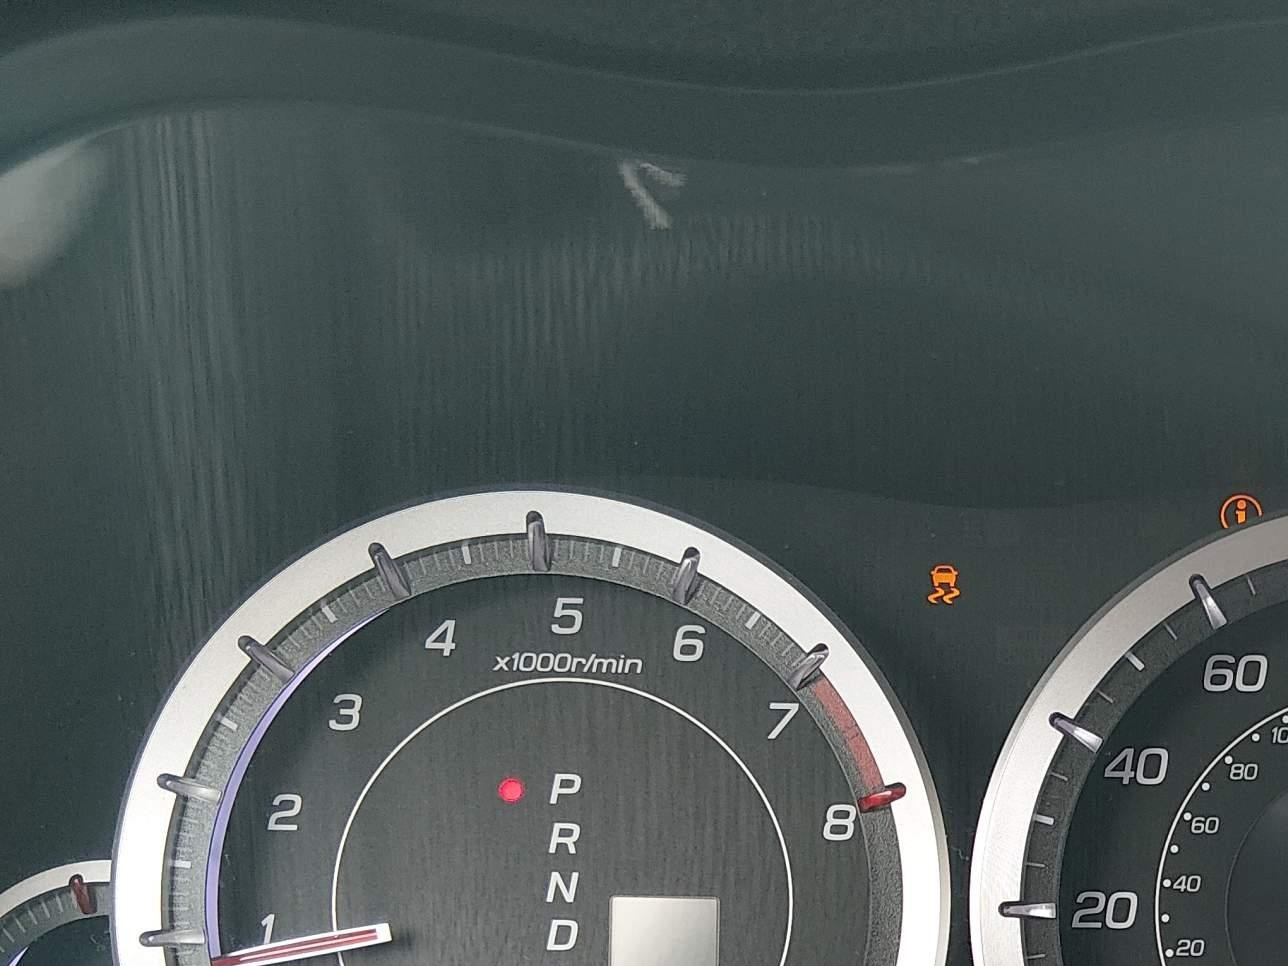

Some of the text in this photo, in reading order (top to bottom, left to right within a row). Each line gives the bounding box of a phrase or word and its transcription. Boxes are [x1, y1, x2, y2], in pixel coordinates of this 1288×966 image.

[551, 597, 583, 634] 5
[425, 619, 456, 656] 4
[673, 625, 705, 662] 6
[493, 653, 643, 674] x1000r/min
[1203, 655, 1268, 692] 60
[328, 693, 363, 731] 3
[767, 702, 800, 739] 7
[1104, 747, 1169, 785] 40
[1229, 763, 1258, 780] 80
[549, 773, 582, 804] P
[267, 793, 302, 831] 2
[822, 804, 857, 841] 8
[1190, 816, 1219, 834] 60
[548, 823, 580, 854] R
[545, 872, 579, 903] N
[1173, 875, 1202, 892] 40
[1071, 891, 1138, 929] 20
[546, 919, 579, 951] D
[1175, 939, 1205, 956] 20
